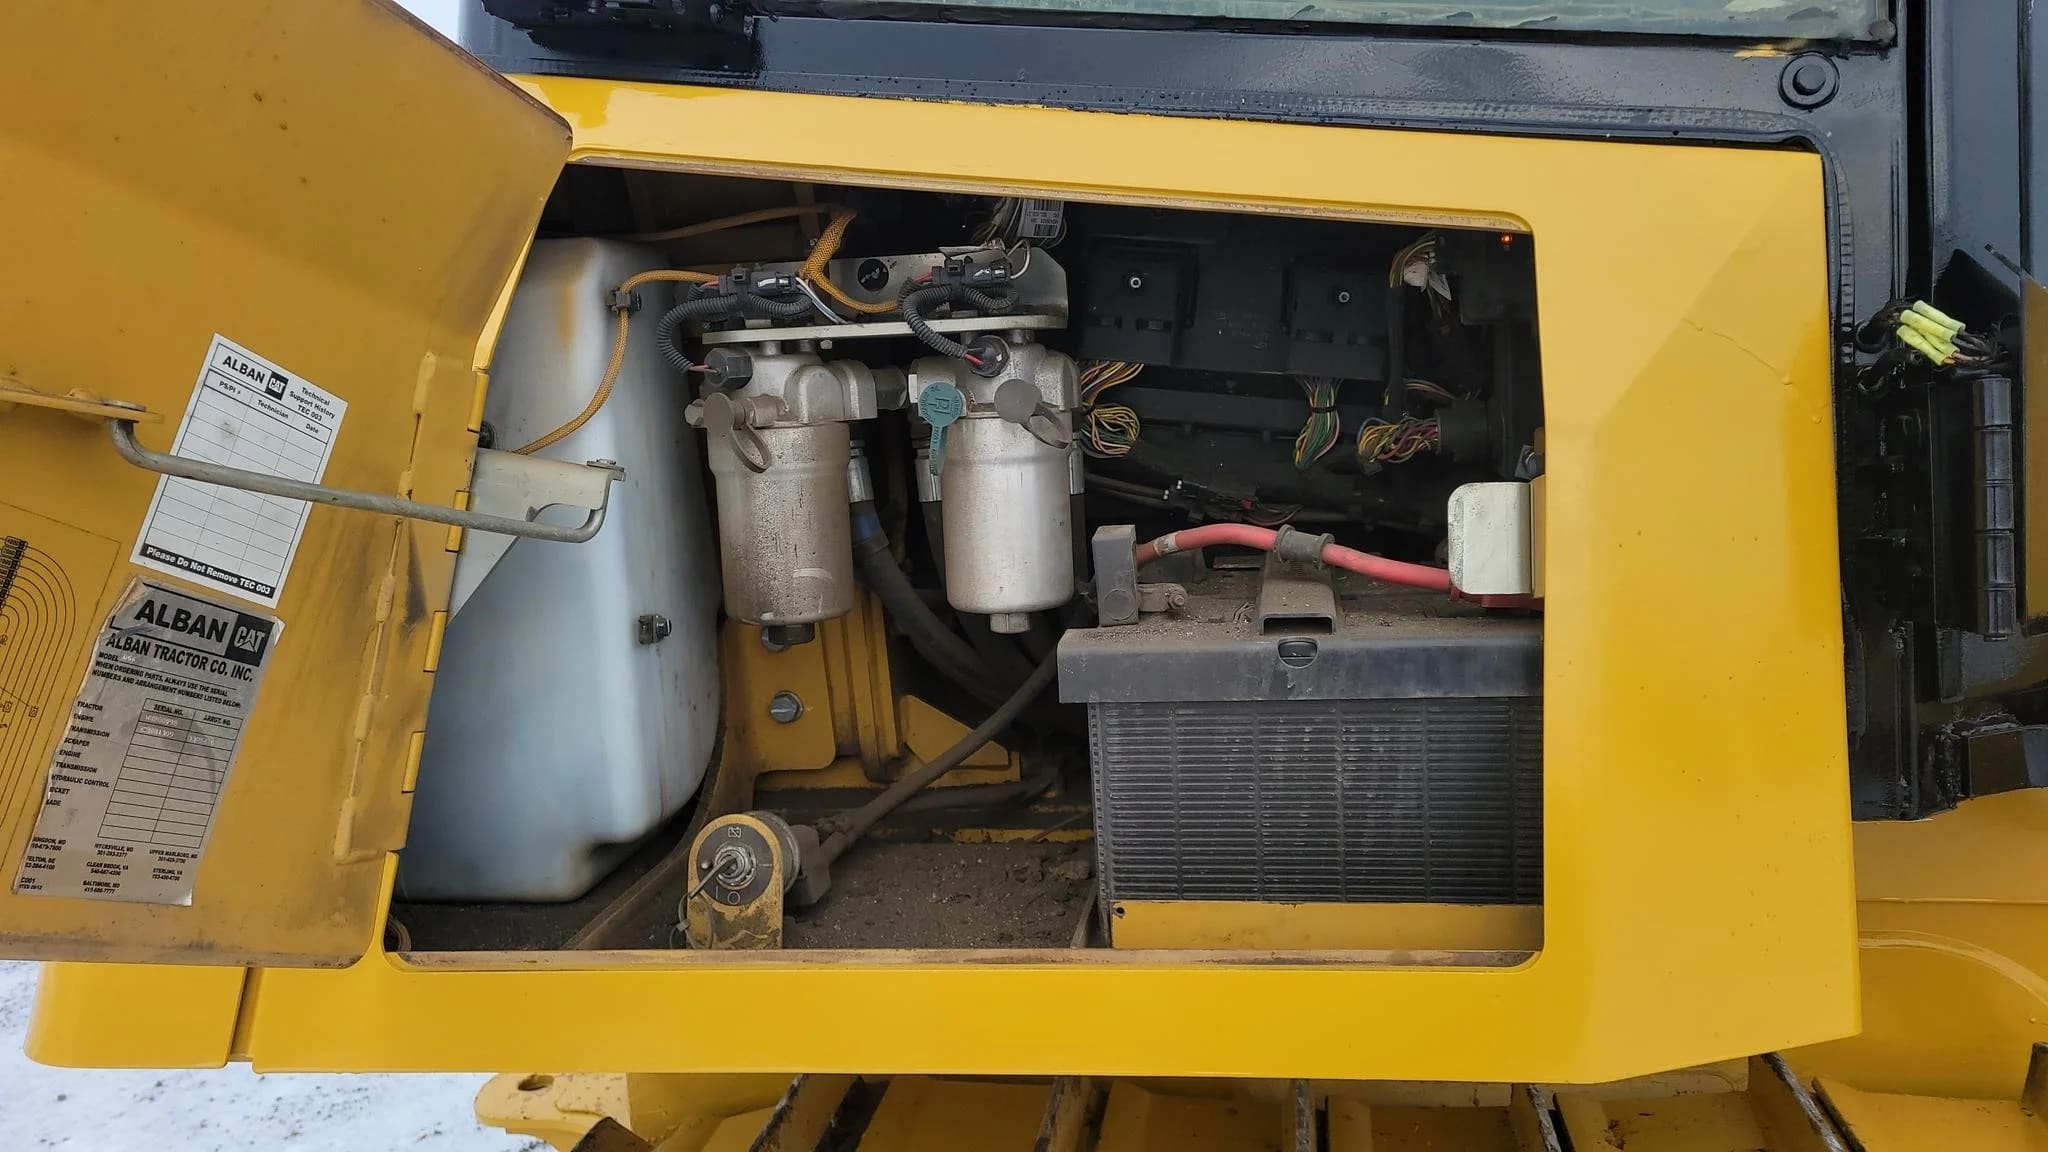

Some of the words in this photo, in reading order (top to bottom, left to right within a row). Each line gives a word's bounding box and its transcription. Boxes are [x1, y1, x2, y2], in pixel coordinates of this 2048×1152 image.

[223, 356, 265, 384] ALBAN
[268, 378, 286, 394] CAT
[301, 387, 330, 405] Technical
[257, 400, 289, 418] Technician
[290, 391, 314, 408] Support
[314, 401, 335, 419] History
[298, 405, 311, 415] TEC
[311, 412, 322, 421] 003
[305, 423, 319, 434] Date
[146, 547, 176, 562] Please
[177, 557, 189, 567] Do
[190, 561, 206, 573] Not
[206, 567, 238, 584] Remove
[240, 579, 256, 589] TEC
[256, 584, 270, 595] 003
[134, 599, 229, 643] ALBAN
[234, 625, 266, 653] CAT
[106, 632, 151, 656] ALBAN
[153, 643, 207, 671] TRACTOR
[210, 660, 228, 676] CO.
[231, 664, 253, 682] INC.
[92, 670, 121, 682] NUMBERS
[122, 677, 134, 685] AND
[135, 679, 178, 694] ARRANGEMENT
[177, 689, 203, 700] NUMBERS
[204, 695, 222, 704] LISTED
[95, 661, 113, 671] WHEN
[114, 665, 144, 678] ORDERING
[164, 677, 186, 688] ALWAYS
[187, 682, 199, 690] USE
[199, 685, 209, 693] THE
[210, 687, 228, 697] SERIAL
[77, 700, 103, 711] TRACTOR
[153, 704, 173, 714] SERIAL
[73, 712, 94, 722] ENGINE
[63, 737, 90, 746] SCRAPER
[59, 749, 81, 758] ENGINE
[55, 761, 98, 773] TRANSMISSION
[84, 779, 110, 788] CONTROL
